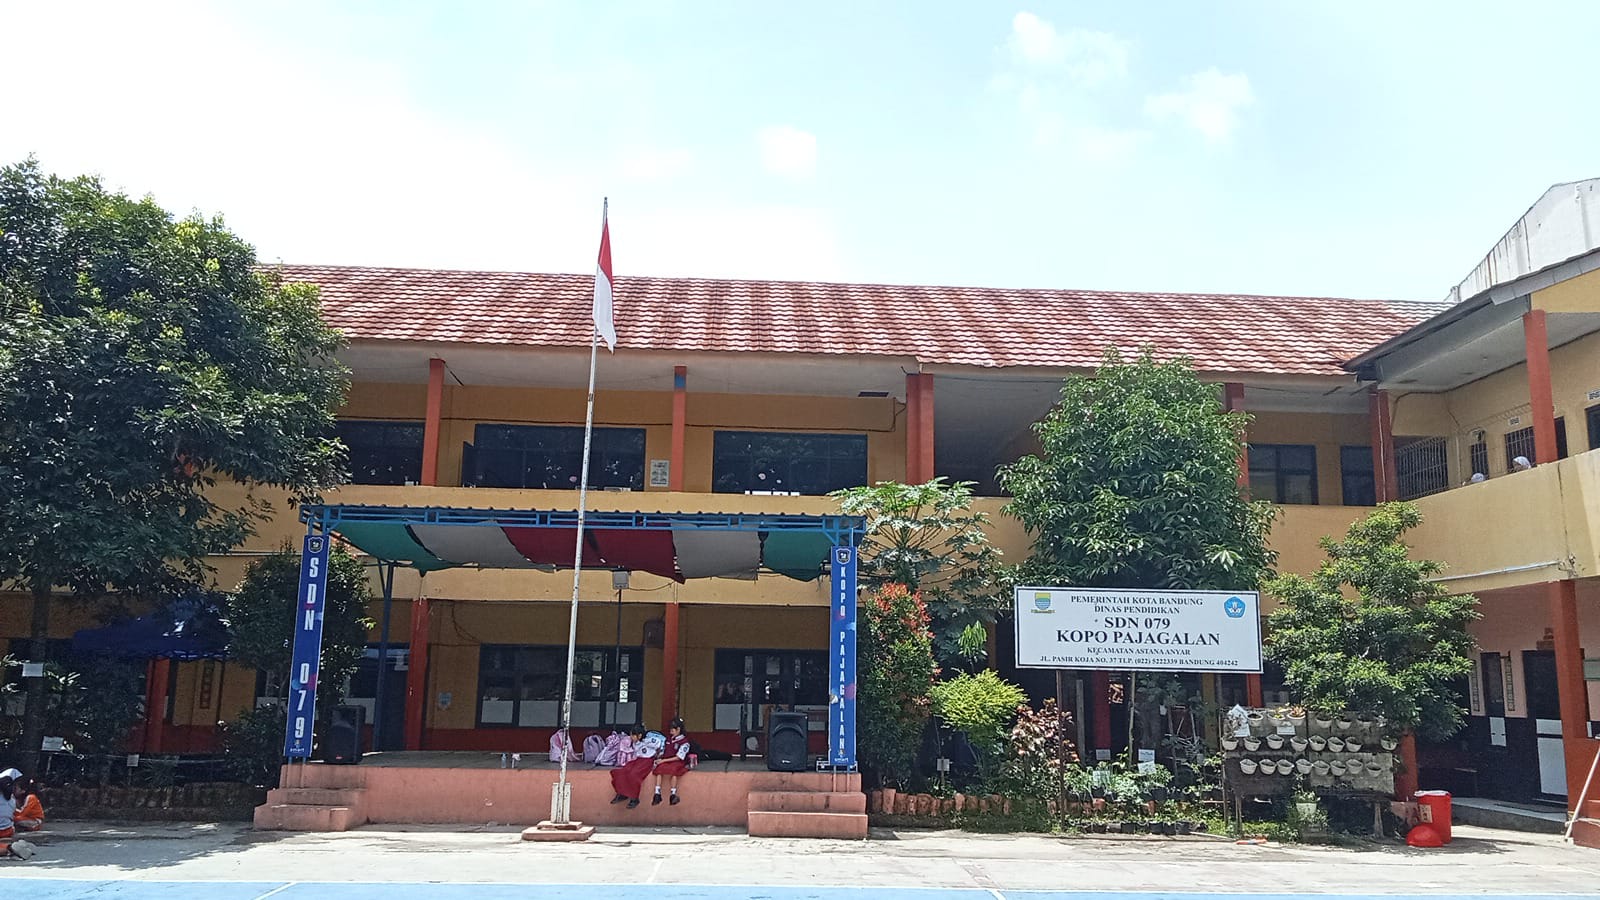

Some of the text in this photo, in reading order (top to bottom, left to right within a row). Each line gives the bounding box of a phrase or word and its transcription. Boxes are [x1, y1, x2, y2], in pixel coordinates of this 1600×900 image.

[304, 557, 319, 630] SDN
[1071, 595, 1203, 606] PEMERINTAH KOTA BANDUNG
[1094, 605, 1180, 614] DINAS PENDIDIKAN
[1104, 616, 1171, 630] SDN 079
[1056, 629, 1220, 646] KOPO PAJAGALAN
[1087, 647, 1134, 655] KECAMATAN
[1134, 657, 1151, 665] (022)
[295, 664, 309, 738] 079
